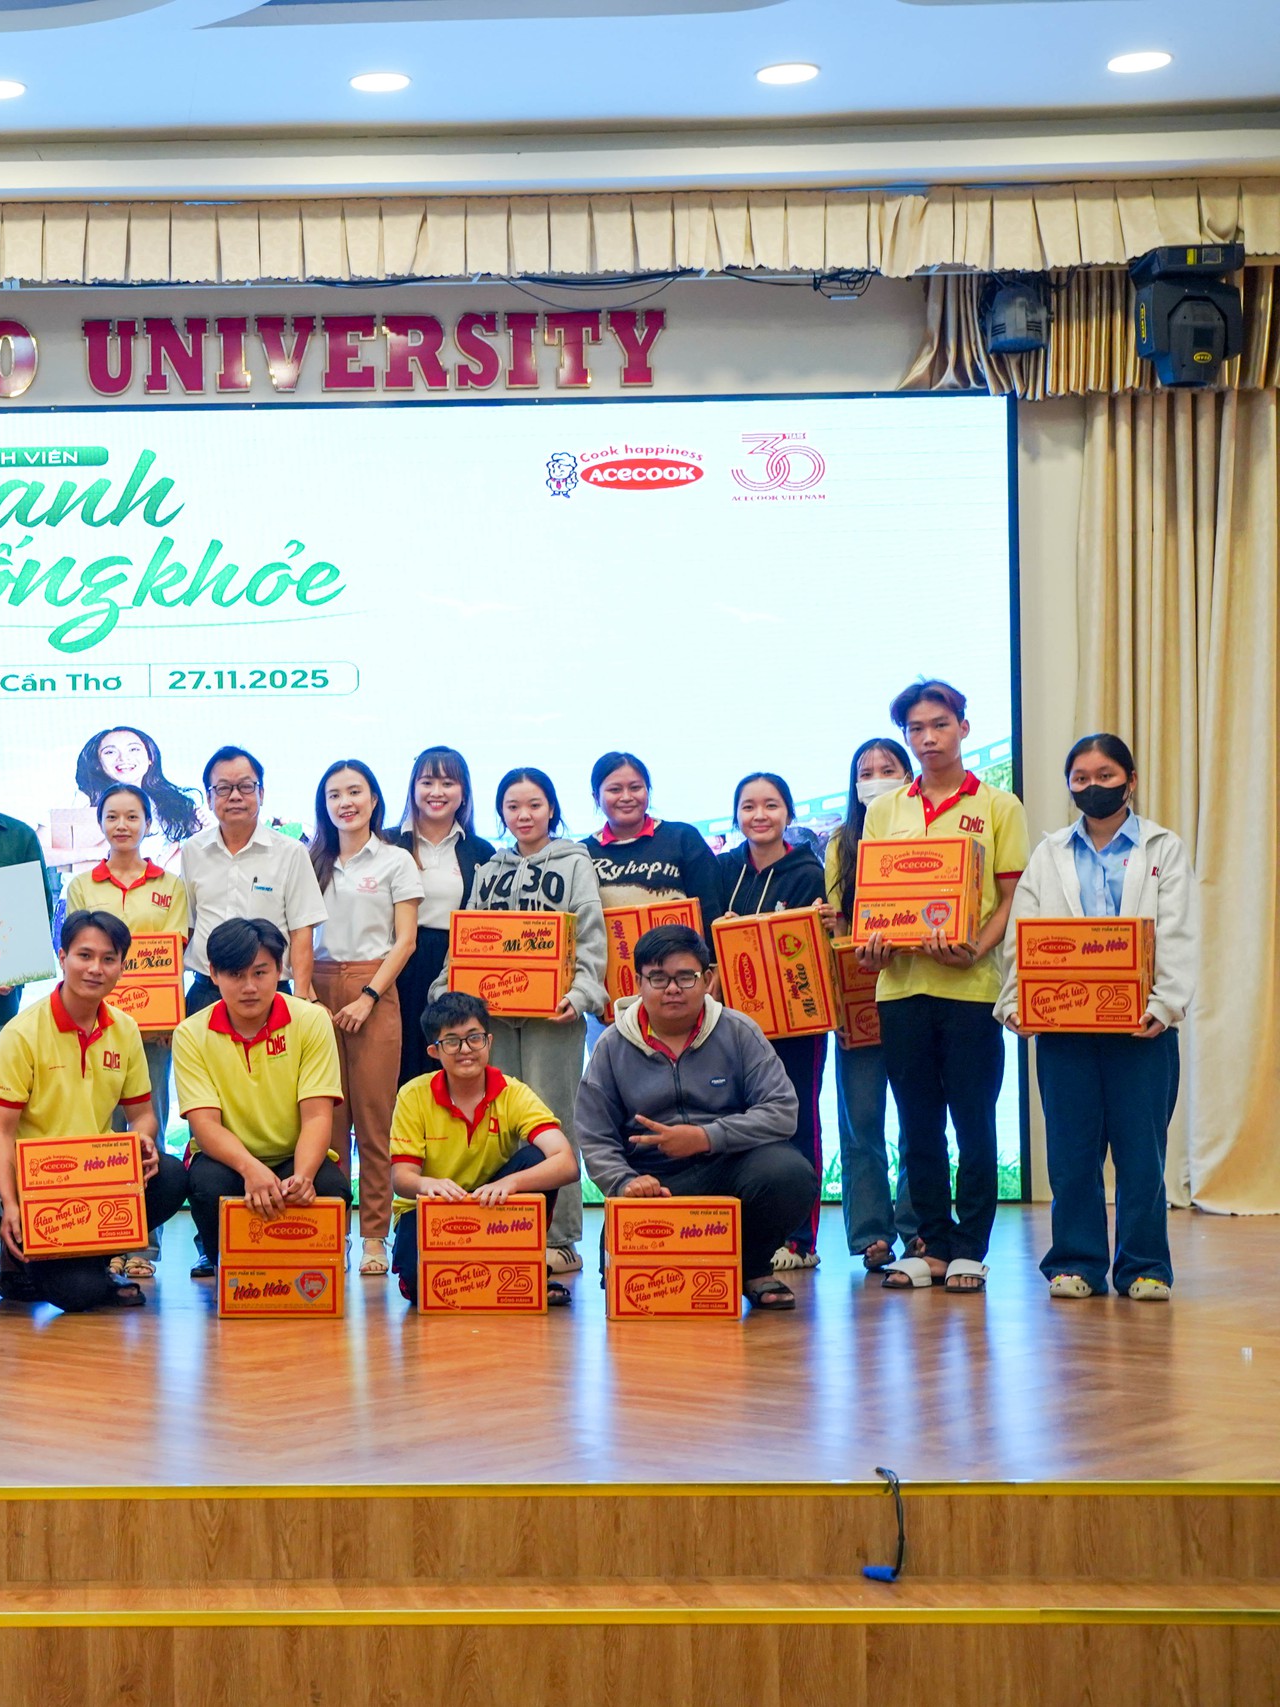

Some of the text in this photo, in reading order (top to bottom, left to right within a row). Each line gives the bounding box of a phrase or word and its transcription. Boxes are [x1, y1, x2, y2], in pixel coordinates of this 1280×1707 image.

[81, 309, 667, 397] UNIVERSITY
[24, 448, 79, 465] VIÊN
[580, 444, 704, 463] Cook happiness
[131, 536, 345, 608] khỏe
[0, 669, 59, 693] Cần
[66, 671, 123, 693] Thơ
[169, 669, 330, 691] 27.11.2025
[959, 815, 985, 834] DNC
[894, 850, 943, 860] Cook happiness
[151, 892, 172, 908] DNC
[865, 910, 917, 930] Hảo Hảo
[503, 937, 554, 953] Mì Xào
[1082, 937, 1128, 955] Hảo Hảo
[141, 956, 172, 969] Xào
[1096, 985, 1131, 1013] 25
[266, 1034, 286, 1056] DNC
[84, 1152, 129, 1172] Hảo Hảo
[98, 1200, 132, 1229] 25
[486, 1217, 533, 1235] Hảo Hảo
[680, 1221, 727, 1238] Hảo Hảo
[233, 1280, 291, 1300] Hảo Hảo
[497, 1266, 533, 1295] 25
[691, 1272, 728, 1300] 25
